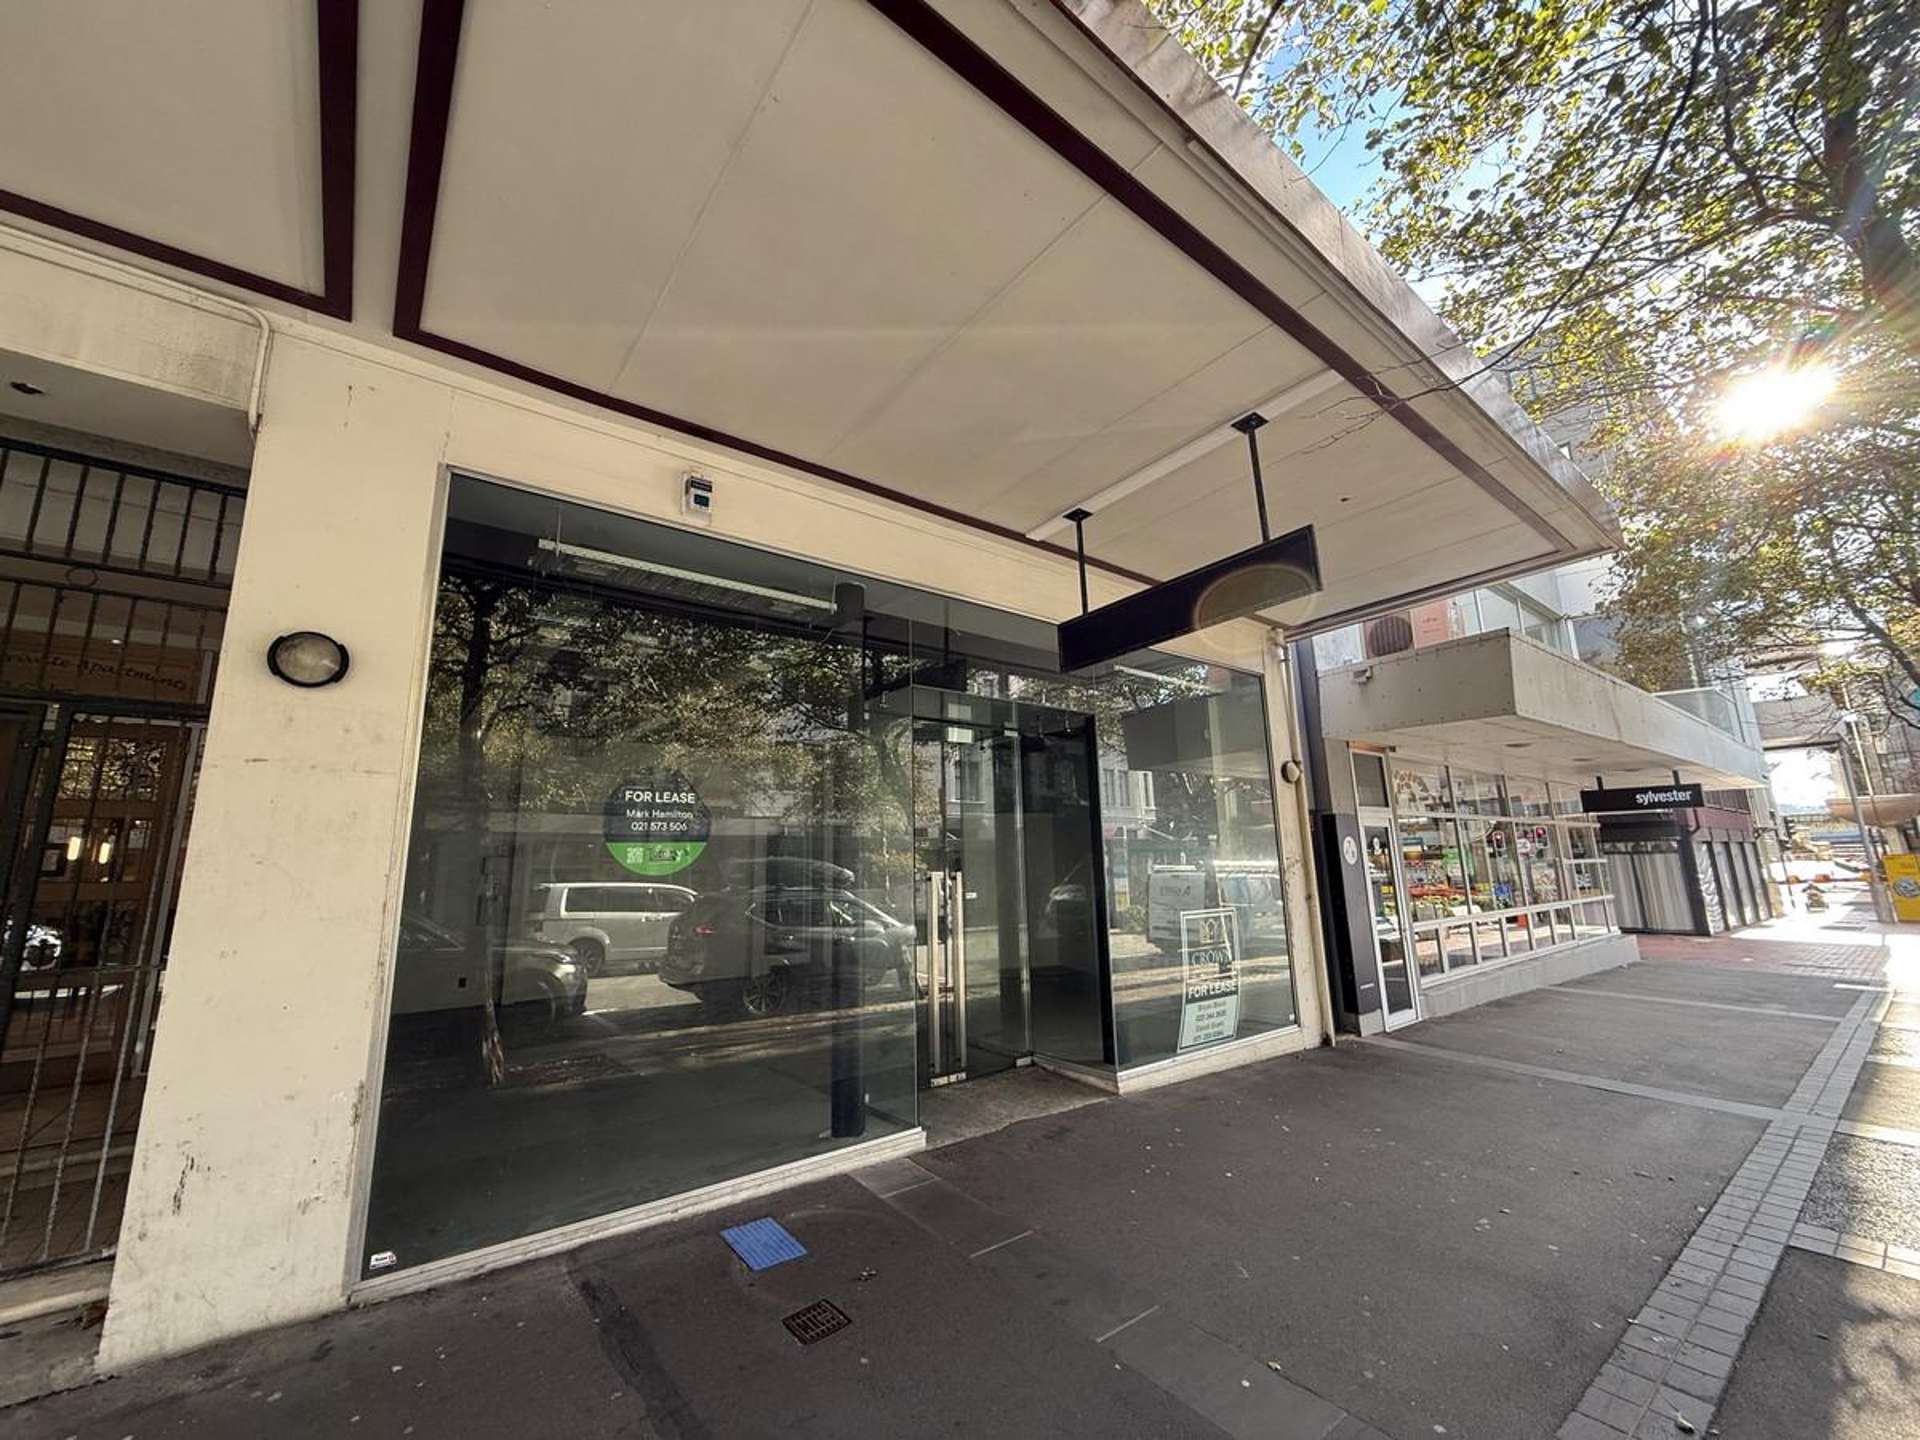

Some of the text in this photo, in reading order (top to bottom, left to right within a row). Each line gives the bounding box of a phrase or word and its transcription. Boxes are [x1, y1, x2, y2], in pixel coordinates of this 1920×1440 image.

[625, 790, 696, 804] FOR LEASE
[1635, 788, 1693, 806] sylvester
[626, 808, 650, 818] Mark
[631, 821, 688, 831] 021 573 506
[1188, 981, 1238, 999] FOR LEASE
